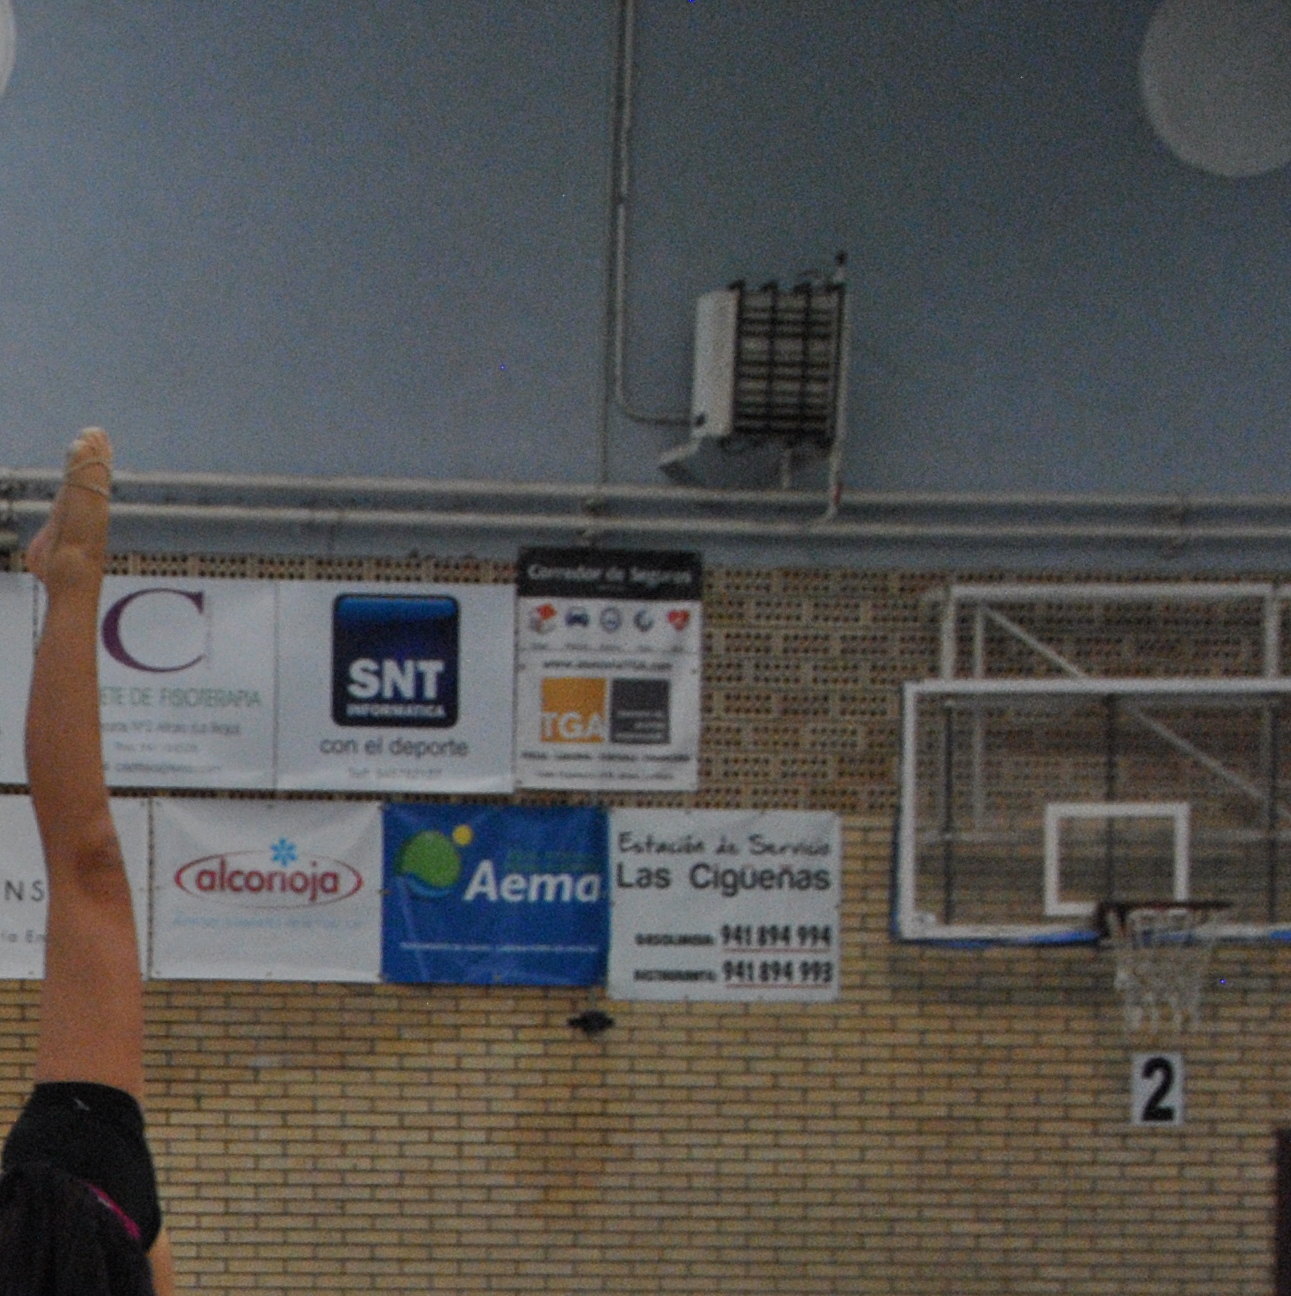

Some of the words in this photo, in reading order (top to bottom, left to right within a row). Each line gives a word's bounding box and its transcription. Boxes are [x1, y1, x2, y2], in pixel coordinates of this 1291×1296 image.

[526, 563, 602, 581] Corredor
[628, 566, 693, 590] Seguros
[347, 657, 446, 700] SNT
[542, 711, 607, 740] TGA
[319, 738, 359, 755] con
[364, 736, 384, 756] el
[388, 737, 469, 759] deporte
[618, 831, 705, 854] Estación
[716, 836, 738, 855] de
[748, 833, 830, 856] Servicio
[462, 859, 602, 904] Aema
[616, 862, 671, 889] Las
[689, 862, 832, 898] Cigüeñas
[721, 923, 753, 947] 941
[756, 924, 791, 947] 894
[796, 924, 833, 947] 994
[723, 959, 755, 983] 941
[759, 960, 794, 983] 894
[799, 960, 834, 984] 993
[1142, 1057, 1175, 1121] 2
